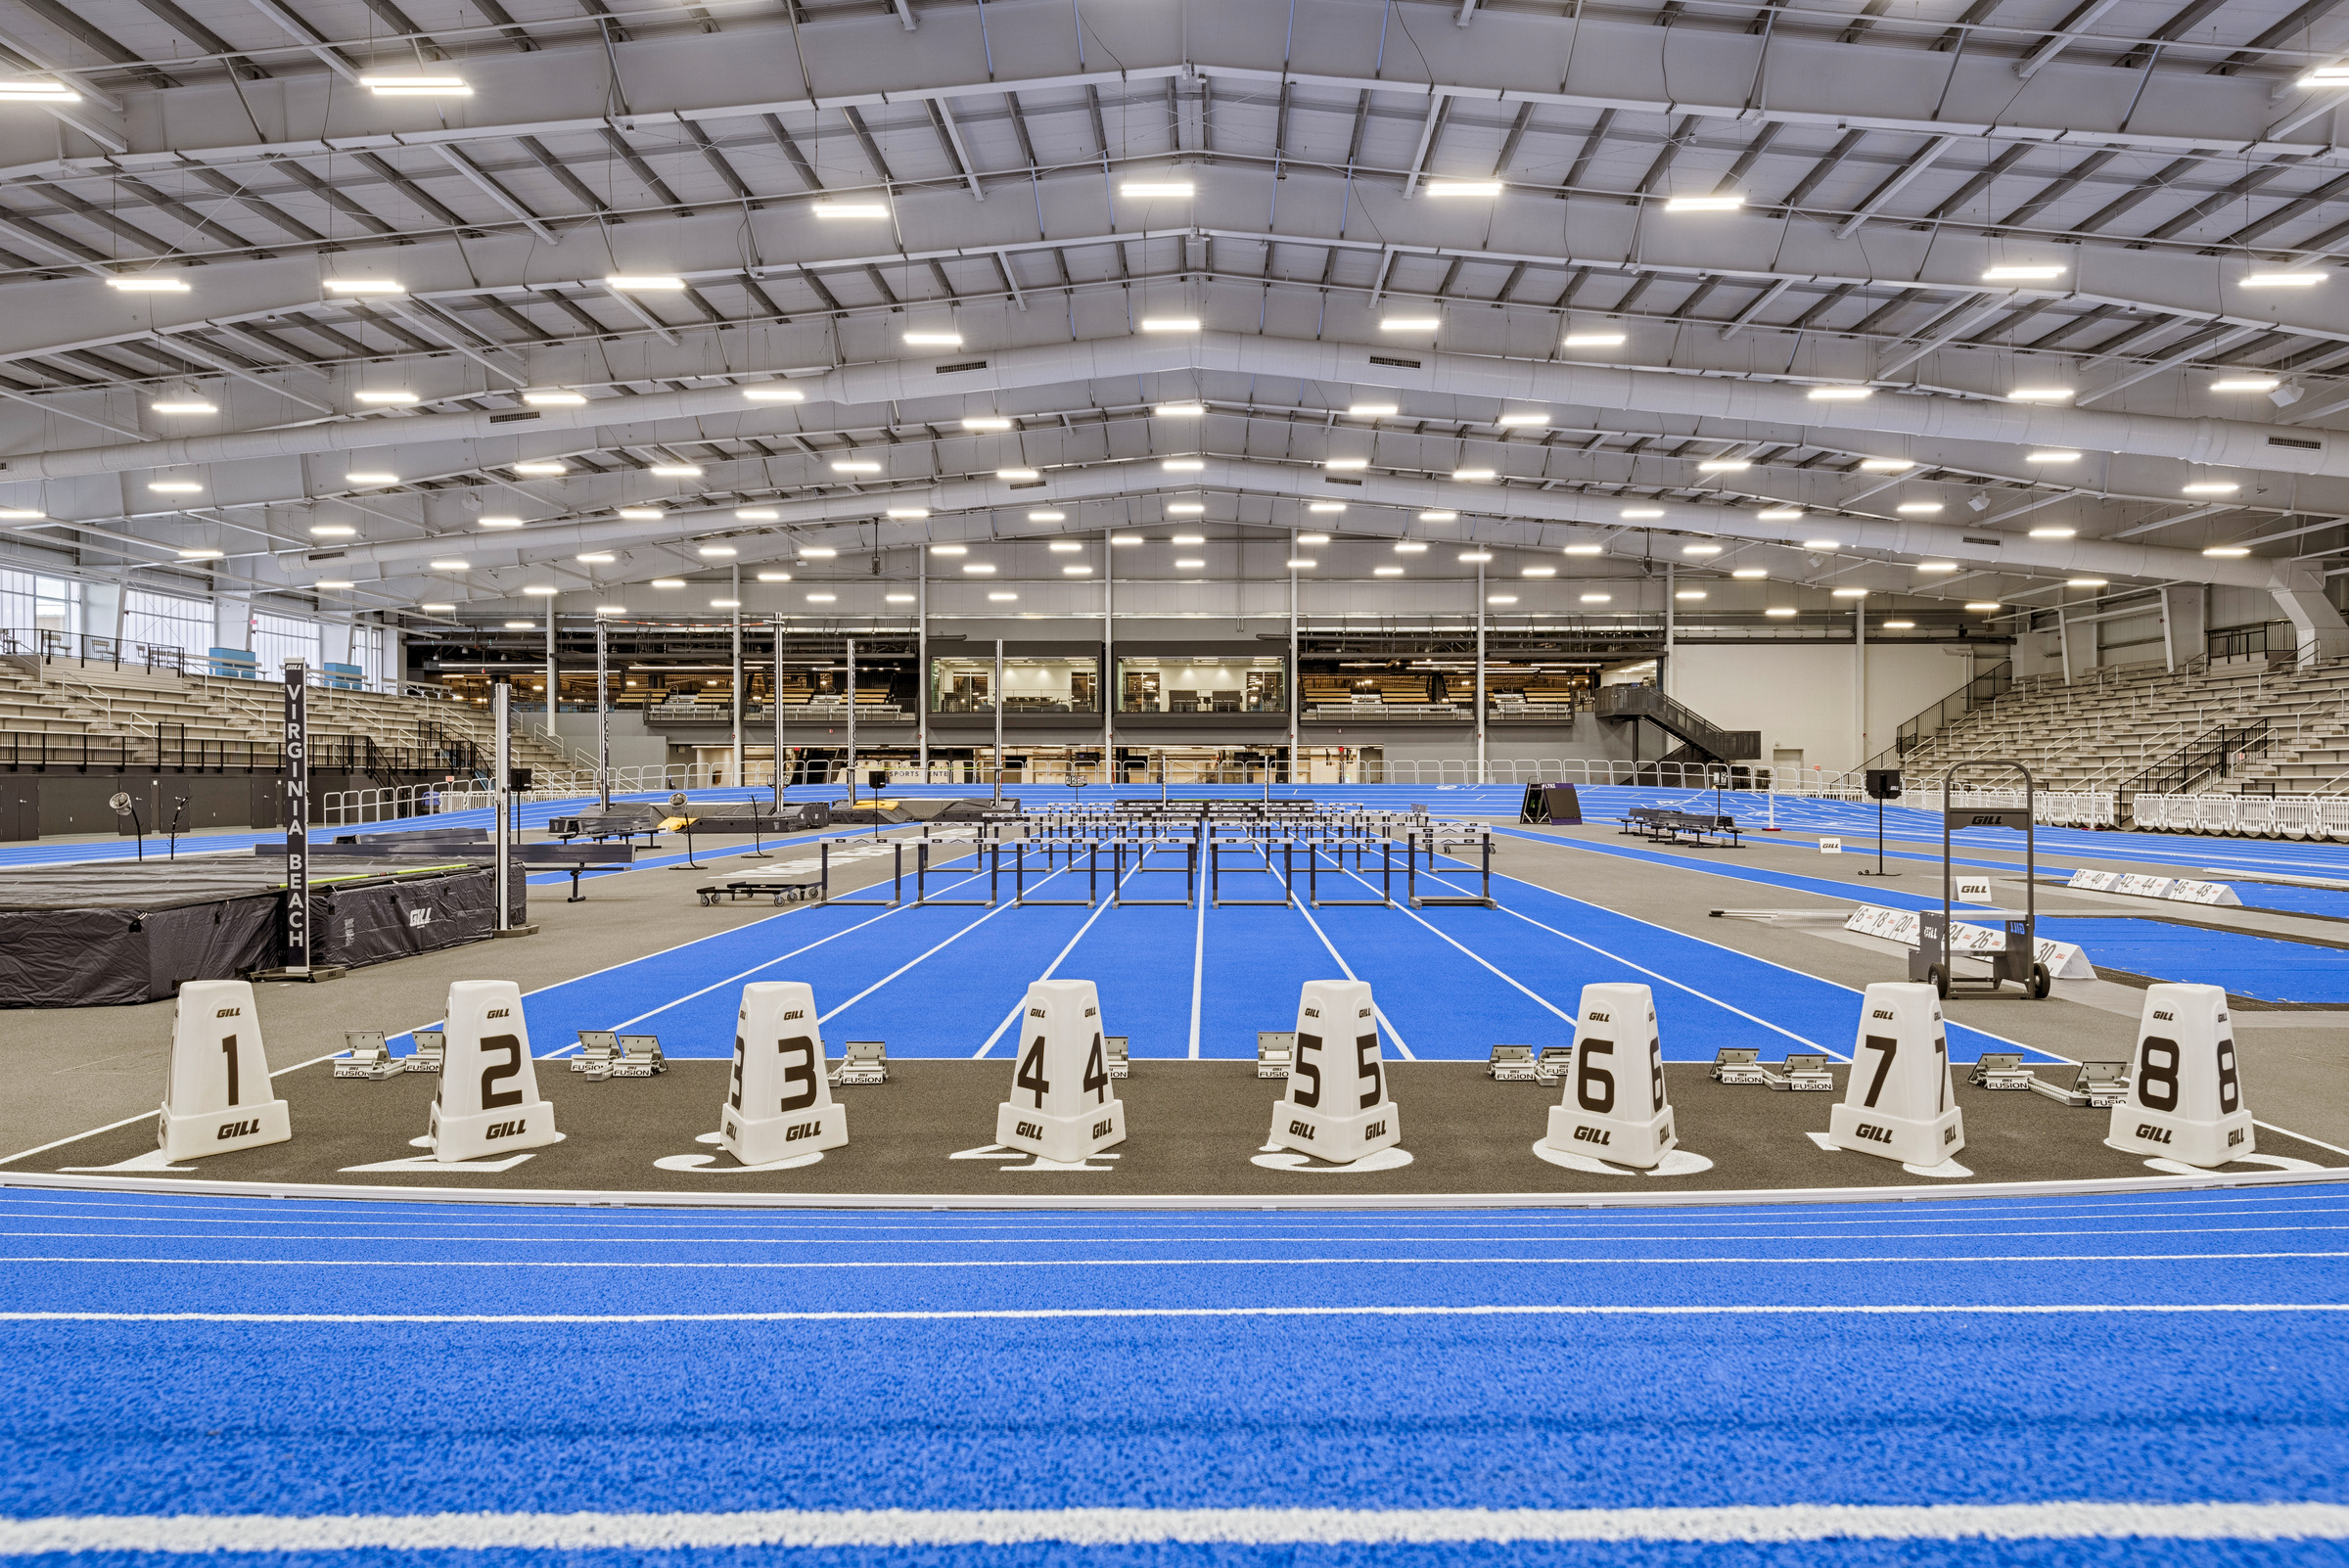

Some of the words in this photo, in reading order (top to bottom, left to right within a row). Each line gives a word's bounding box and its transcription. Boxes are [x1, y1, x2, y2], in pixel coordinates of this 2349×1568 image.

[287, 685, 303, 835] VIRGINIA
[1971, 815, 2003, 825] GILL
[1960, 885, 1988, 894] GILL
[289, 854, 303, 946] BEACH
[1872, 911, 1890, 928] 18
[1895, 915, 1914, 933] 20
[1969, 931, 1994, 948] 26
[2034, 943, 2056, 962] 30
[216, 1007, 241, 1018] GILL
[486, 1008, 510, 1019] GILL
[783, 1010, 804, 1021] GILL
[1030, 1008, 1045, 1018] GILL
[1084, 1006, 1096, 1018] GILL
[1305, 1007, 1320, 1018] GILL
[1359, 1007, 1371, 1018] GILL
[1589, 1011, 1610, 1023] GILL
[1872, 1009, 1894, 1021] GILL
[2152, 1010, 2174, 1022] GILL
[222, 1034, 239, 1106] 1
[480, 1034, 523, 1111] 2
[778, 1036, 817, 1113] 3
[1017, 1036, 1049, 1109] 4
[1083, 1032, 1108, 1104] 4
[1294, 1032, 1323, 1108] 5
[1357, 1033, 1381, 1110] 5
[1577, 1038, 1615, 1114] 6
[1864, 1035, 1898, 1108] 7
[2139, 1036, 2180, 1113] 8
[2217, 1038, 2238, 1115] 8
[217, 1119, 260, 1140] GILL
[485, 1119, 527, 1140] GILL
[725, 1121, 737, 1141] GILL
[785, 1121, 821, 1142] GILL
[1015, 1121, 1043, 1141] GILL
[1092, 1118, 1113, 1140] GILL
[1289, 1120, 1315, 1140] GILL
[1365, 1120, 1387, 1140] GILL
[1573, 1125, 1611, 1146] GILL
[1659, 1124, 1670, 1145] GILL
[1855, 1123, 1893, 1144] GILL
[1944, 1125, 1957, 1145] GILL
[2136, 1124, 2173, 1144] GILL
[2228, 1128, 2244, 1147] GILL
